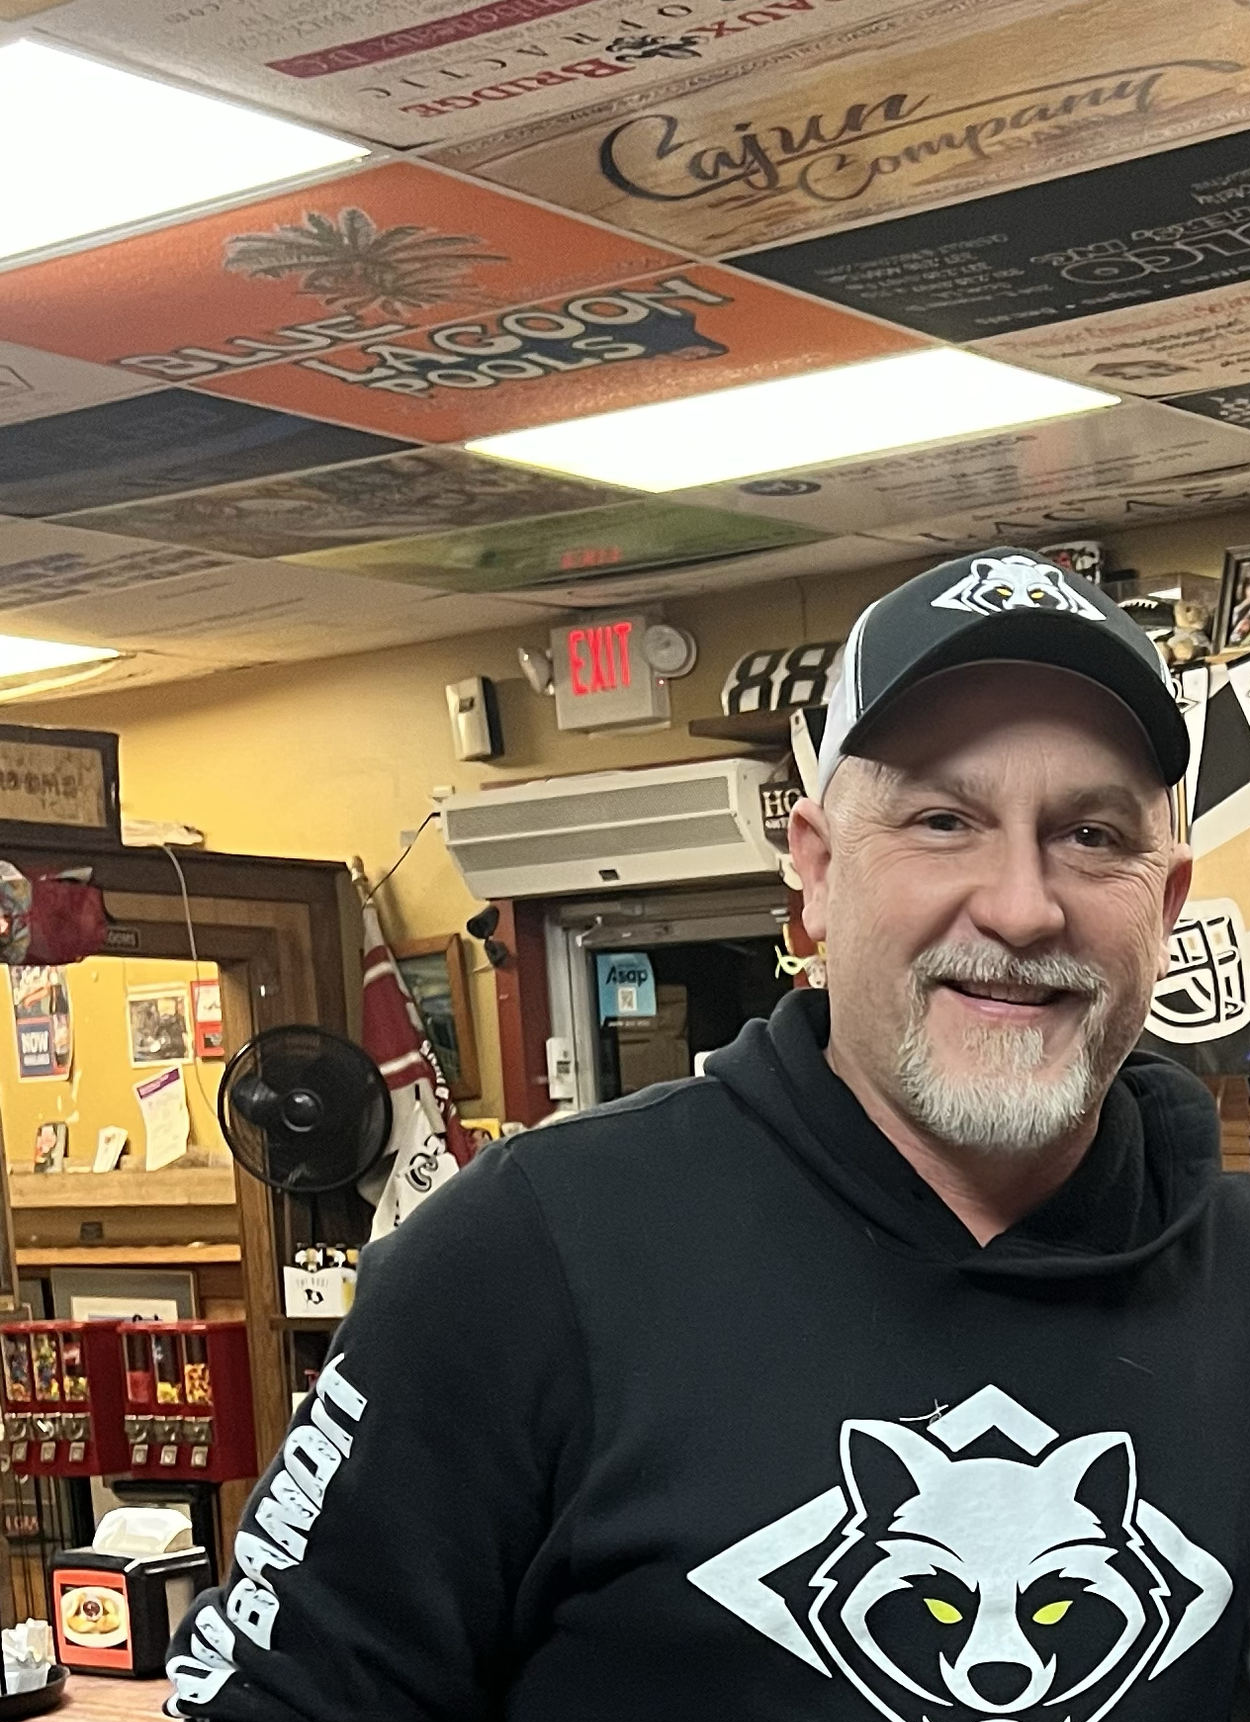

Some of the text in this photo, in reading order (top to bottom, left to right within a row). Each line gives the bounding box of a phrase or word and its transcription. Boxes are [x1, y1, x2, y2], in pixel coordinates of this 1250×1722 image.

[602, 92, 932, 202] Cajun
[797, 72, 1166, 201] Company
[110, 312, 412, 384] BLUE
[299, 276, 736, 386] LAGOON
[368, 334, 648, 399] POOLS
[569, 622, 634, 697] EXIT
[605, 965, 648, 987] Asap
[21, 1031, 49, 1054] NOW
[226, 1352, 368, 1651] BANDIT
